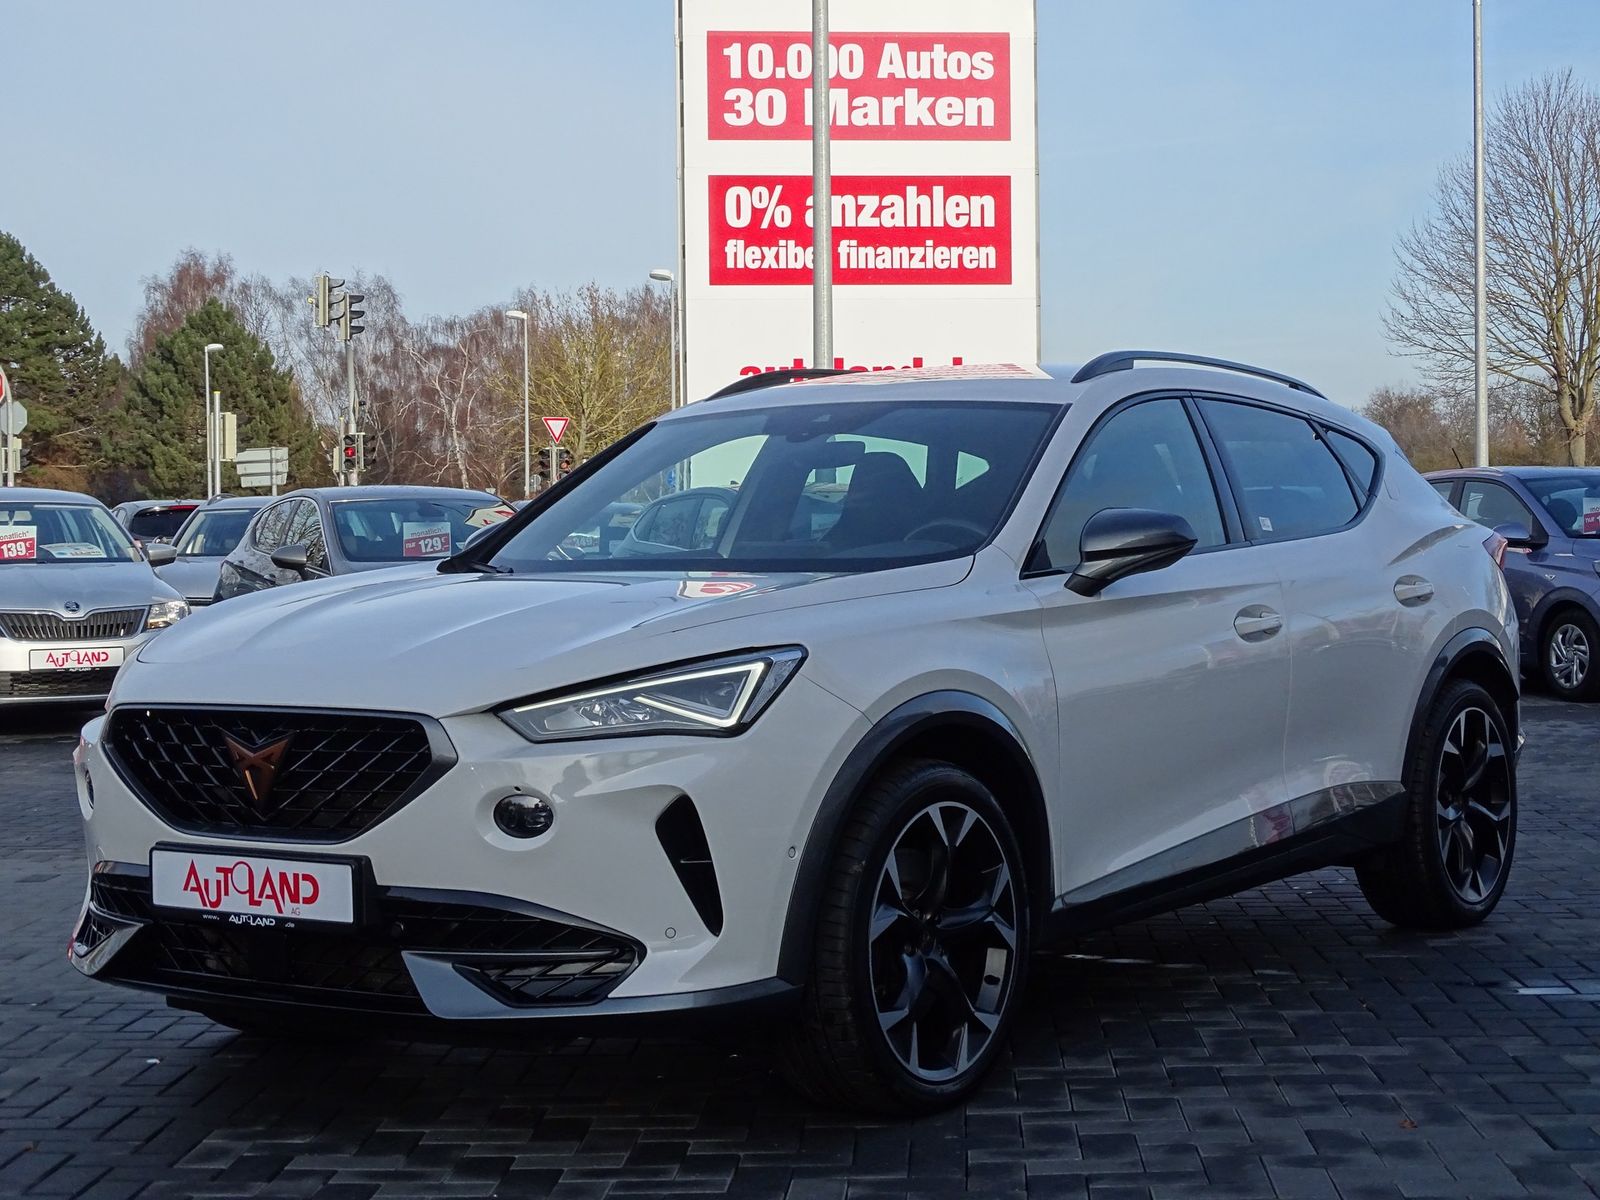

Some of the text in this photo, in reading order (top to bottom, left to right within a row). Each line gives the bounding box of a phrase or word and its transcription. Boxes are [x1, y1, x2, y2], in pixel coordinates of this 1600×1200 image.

[877, 43, 995, 80] Autos
[723, 88, 995, 127] 30 Marken
[725, 185, 792, 229] 0%
[725, 239, 997, 270] flexibe finanzieren
[46, 649, 109, 667] AUTOLAND
[183, 859, 320, 914] AUTOLAND
[228, 914, 276, 927] AUTOLAND
[290, 907, 300, 916] AG
